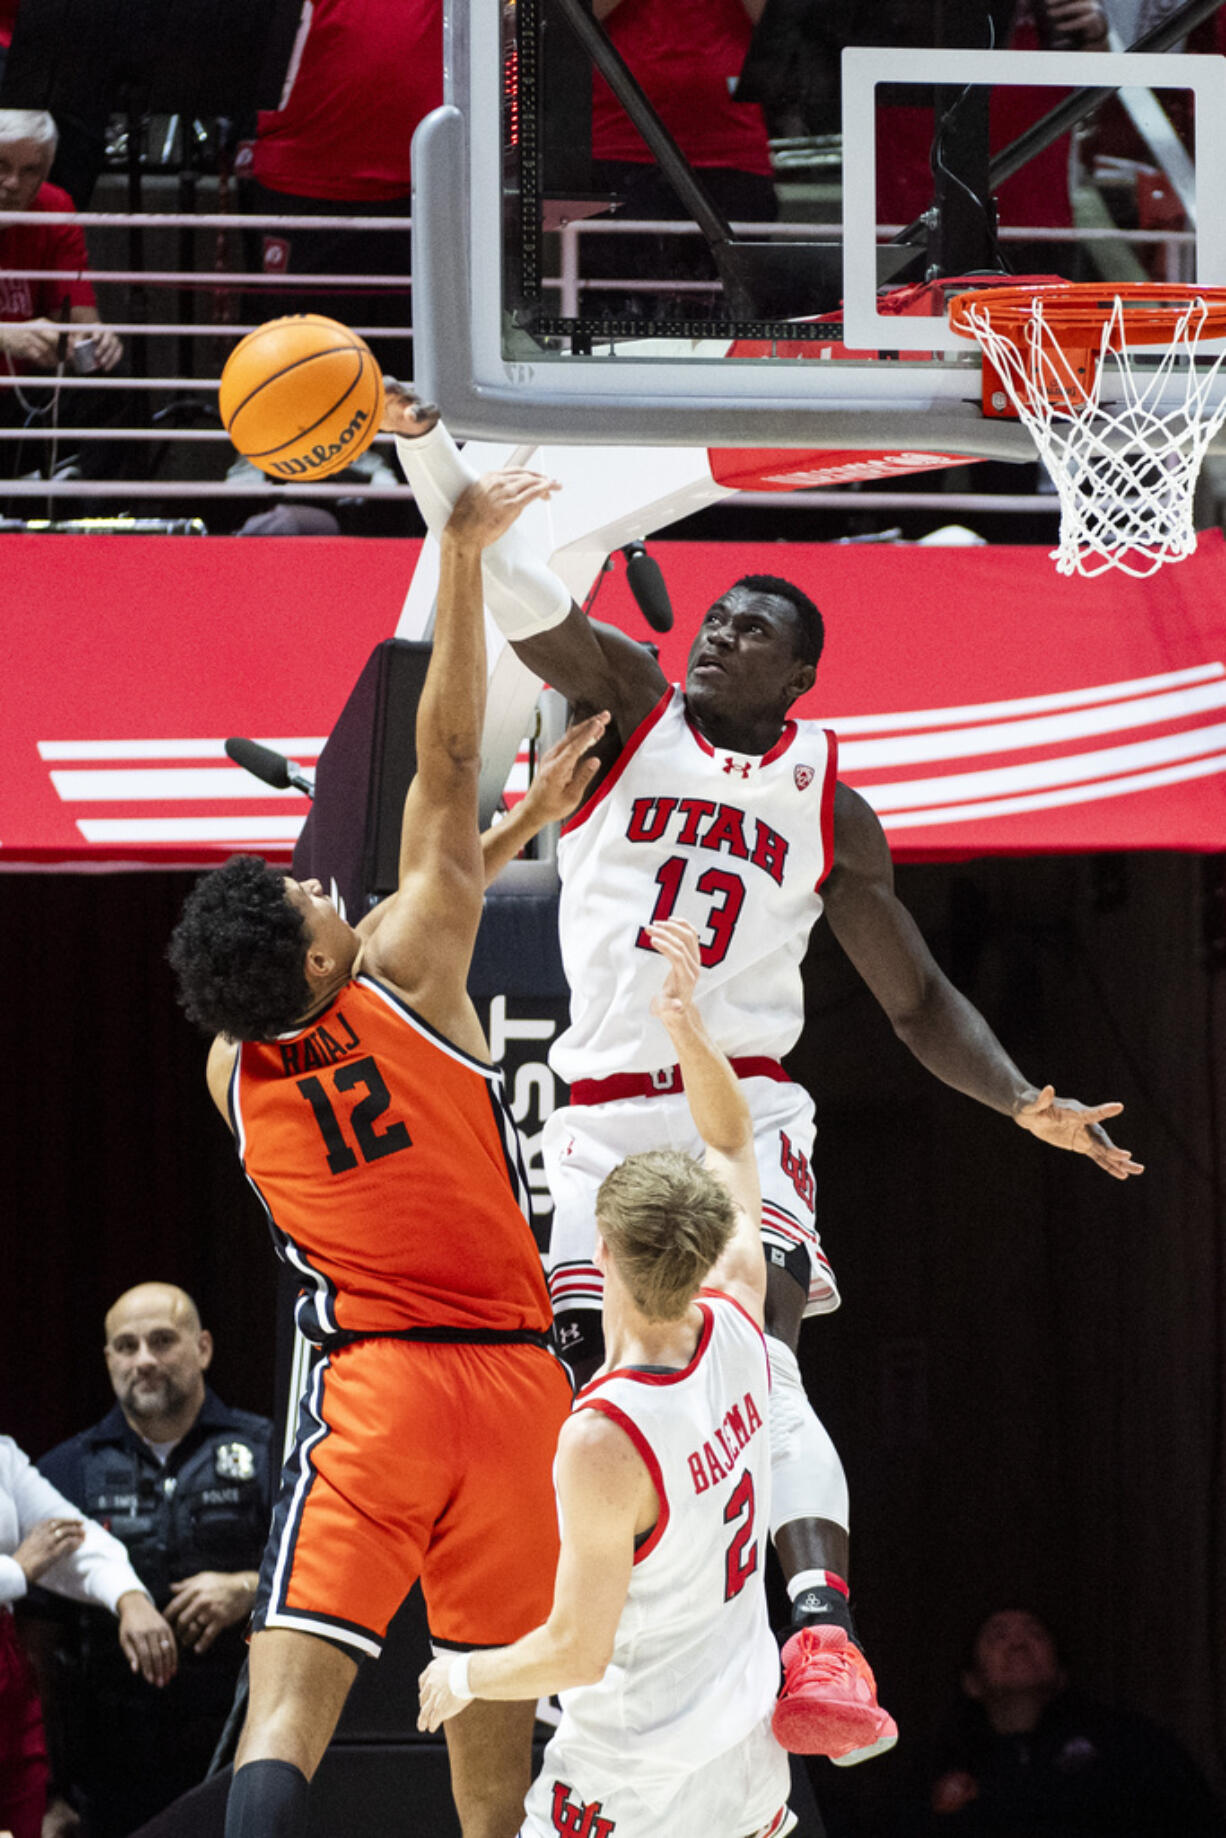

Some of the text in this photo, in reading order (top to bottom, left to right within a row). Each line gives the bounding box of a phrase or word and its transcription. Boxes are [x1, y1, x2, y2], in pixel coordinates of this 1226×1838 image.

[270, 409, 368, 475] Wilson
[626, 797, 789, 888] UTAH
[635, 855, 746, 969] 13
[280, 1012, 360, 1077] RATAJ
[296, 1055, 413, 1176] 12
[687, 1392, 763, 1495] BAJEMA
[723, 1467, 758, 1604] 2
